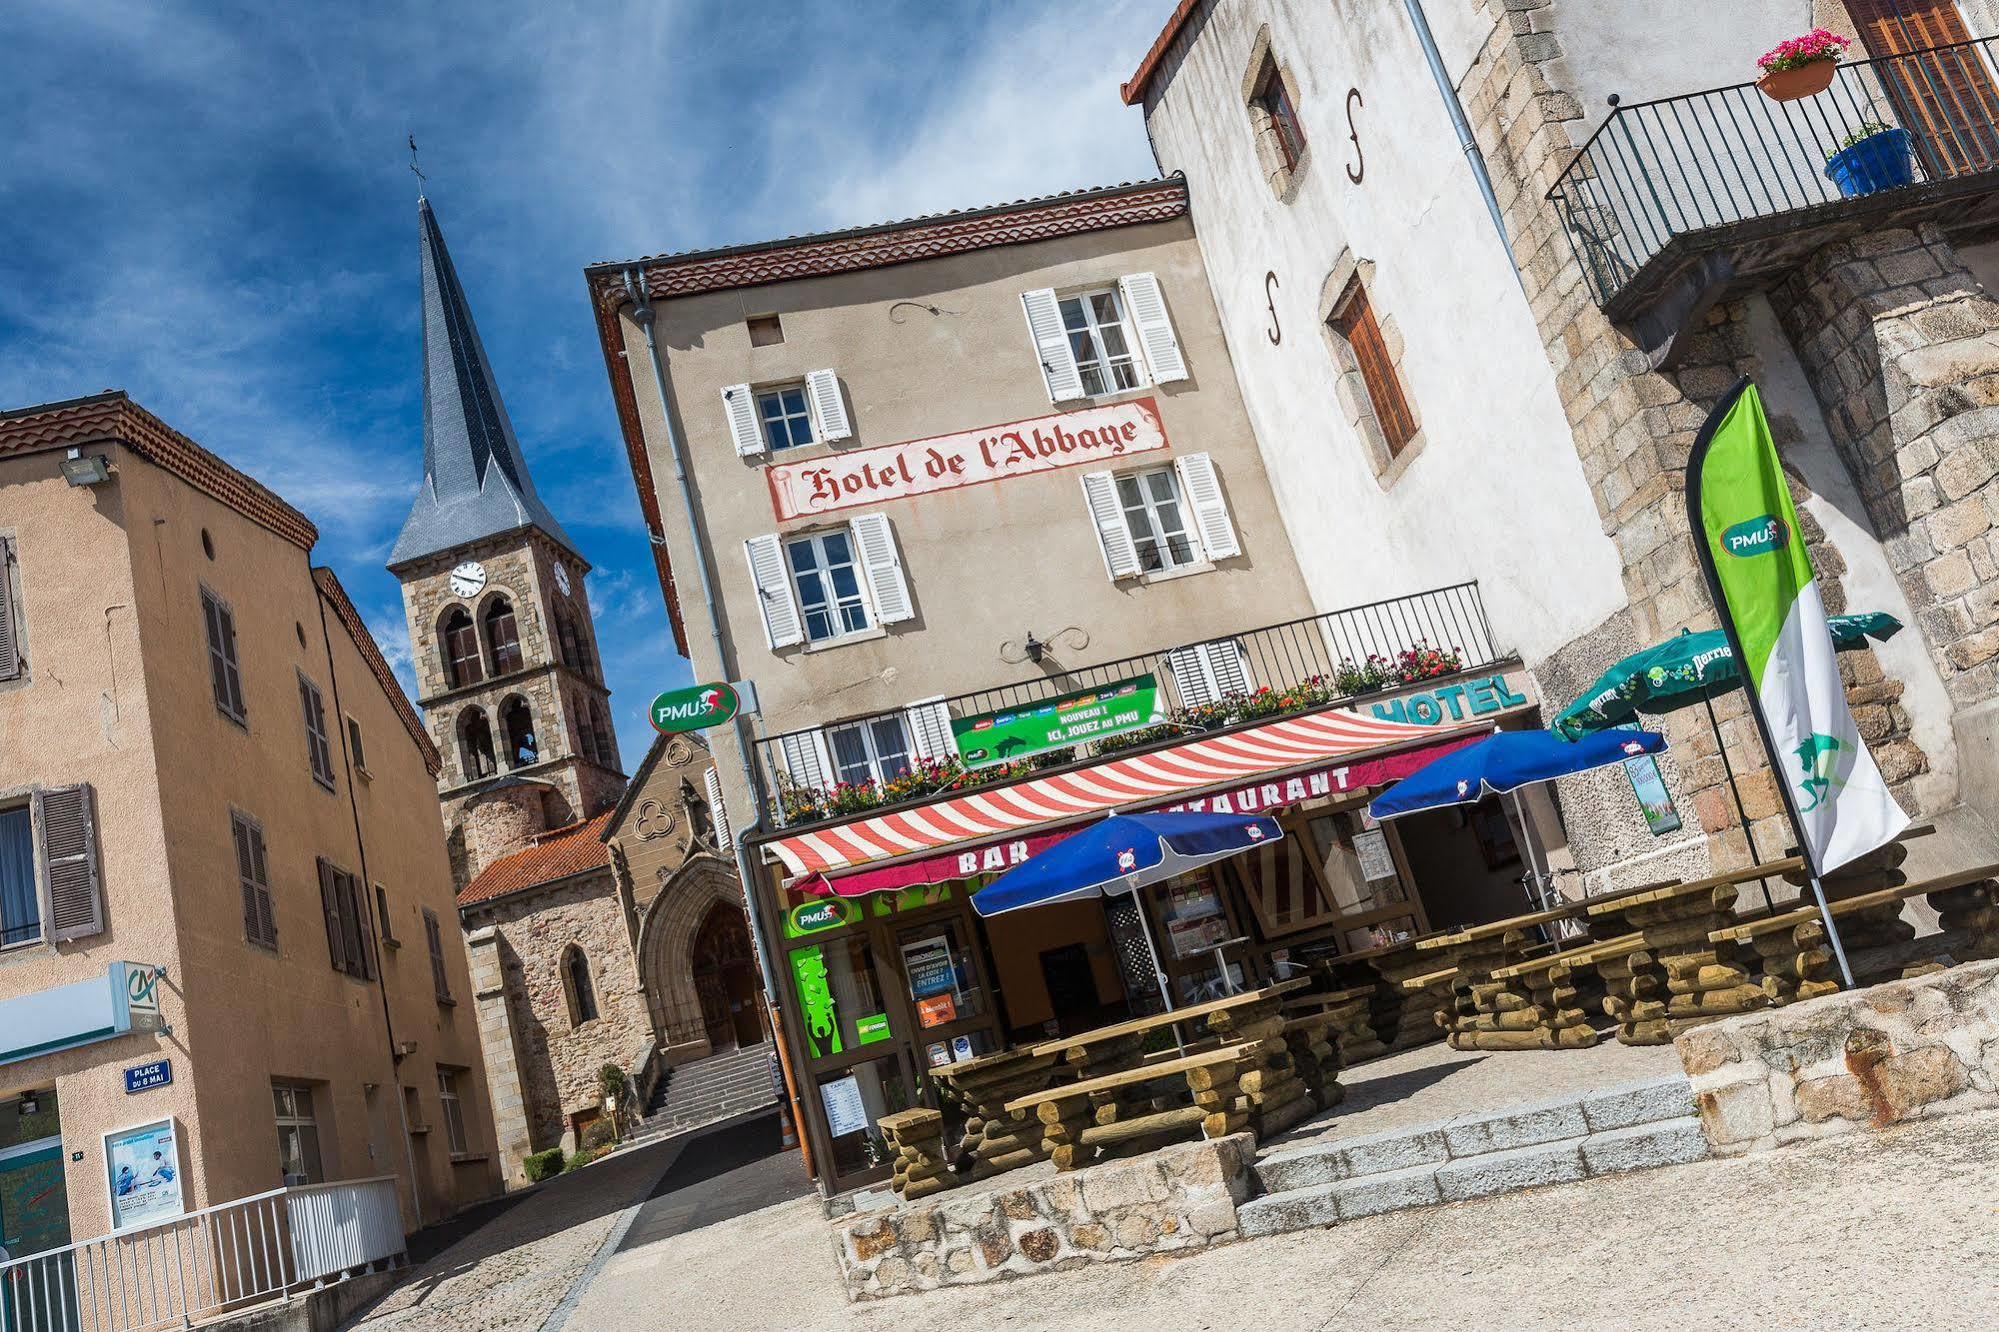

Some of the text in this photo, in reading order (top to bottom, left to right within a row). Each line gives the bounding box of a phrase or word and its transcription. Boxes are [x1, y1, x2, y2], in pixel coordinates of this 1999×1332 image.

[802, 420, 1138, 508] Hotel de l'Abbaye
[1730, 528, 1769, 550] PMU
[1692, 646, 1732, 681] Perrie
[1371, 674, 1527, 726] HOTEL
[657, 700, 700, 723] PMU
[1060, 706, 1102, 725] NOUVEAU
[1048, 729, 1065, 742] ICI,
[1067, 721, 1100, 738] JOUEZ
[1115, 711, 1139, 727] PMU
[958, 841, 1030, 874] BAR
[800, 911, 824, 926] PMU
[916, 974, 946, 988] ENTREZ
[132, 1073, 164, 1088] DU 8 MAI
[134, 1064, 160, 1078] PLACE
